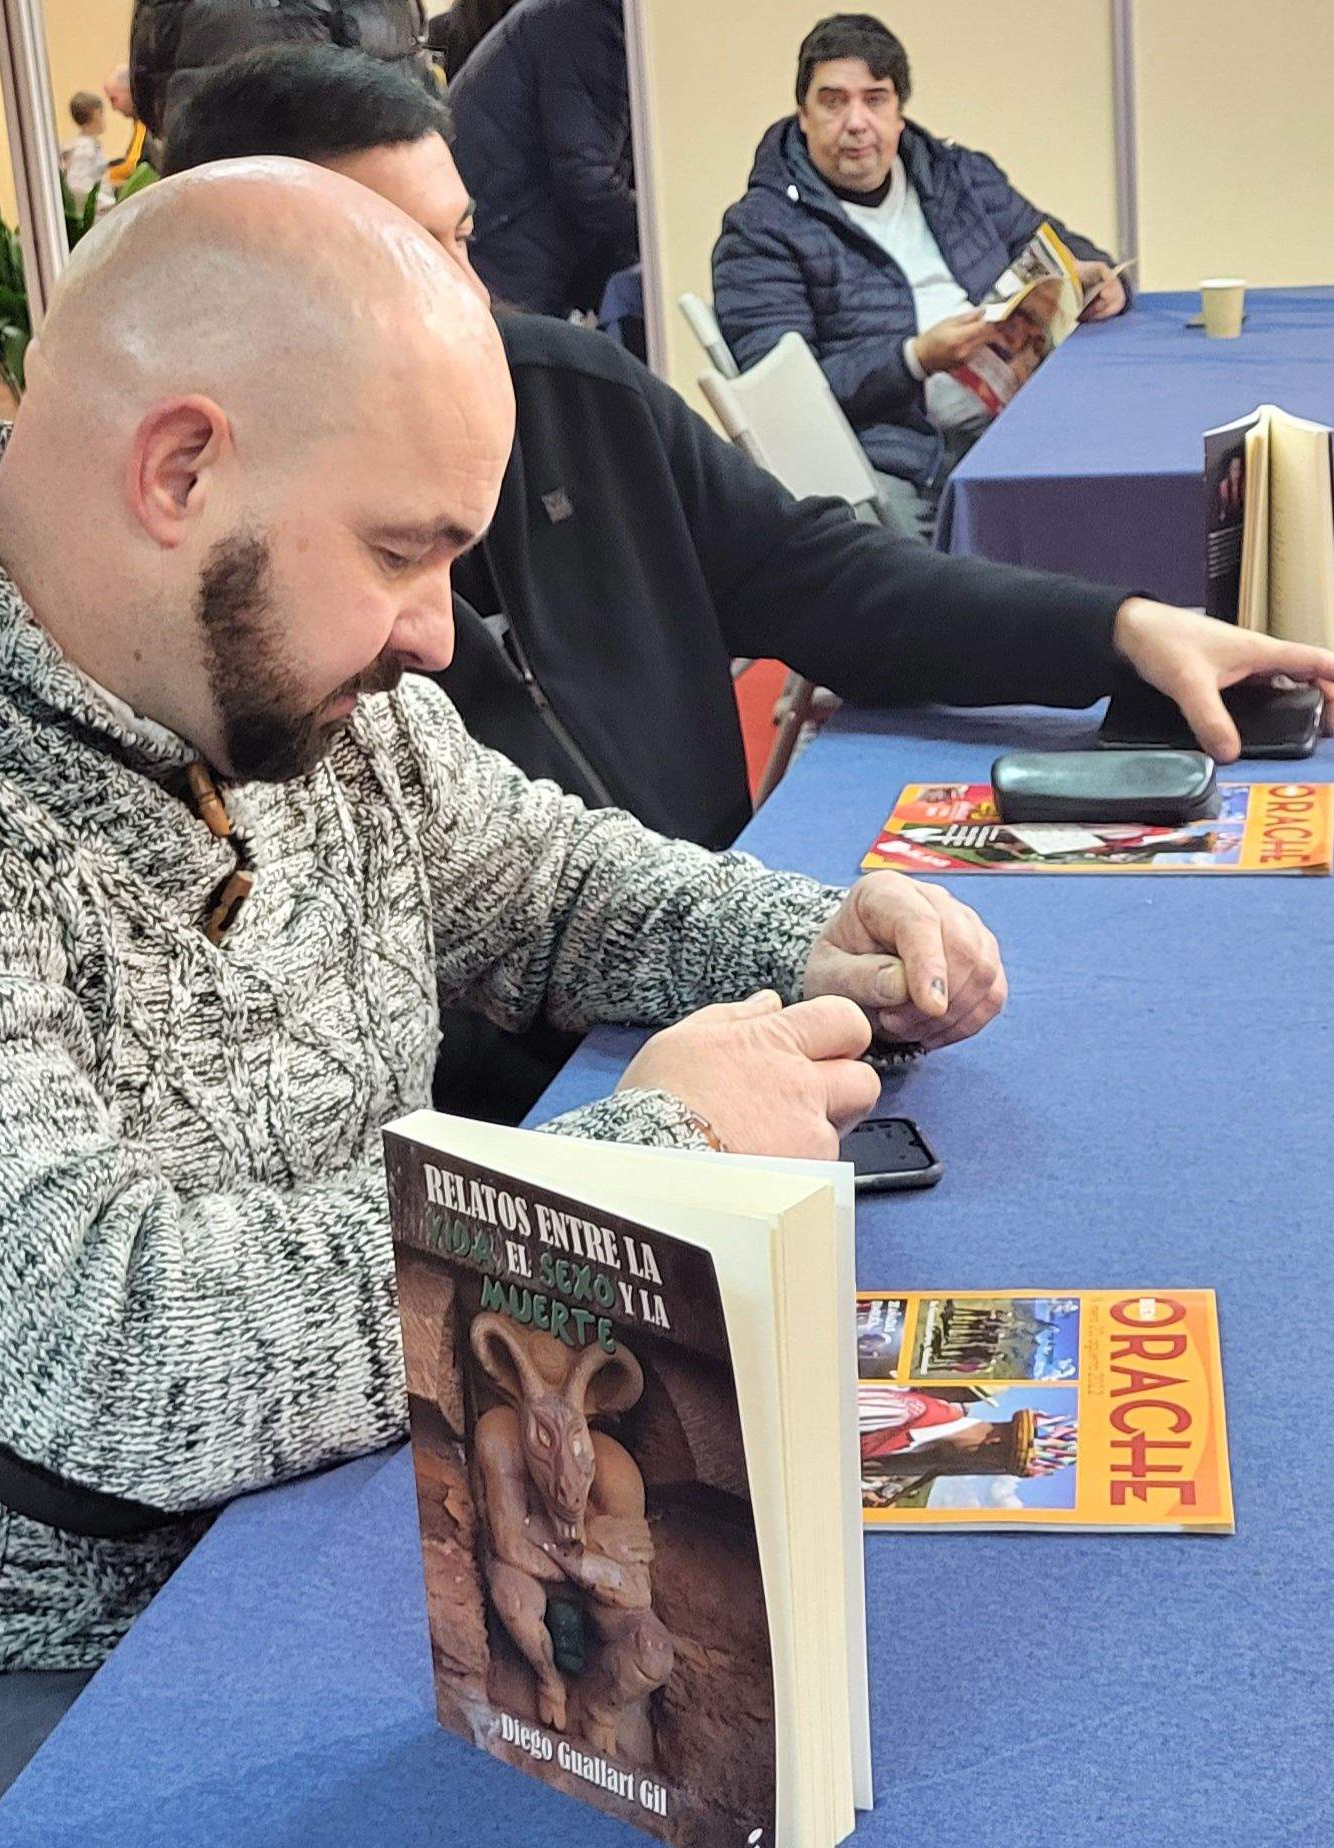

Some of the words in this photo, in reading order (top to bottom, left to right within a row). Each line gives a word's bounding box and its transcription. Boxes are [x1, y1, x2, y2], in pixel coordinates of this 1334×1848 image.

[1260, 785, 1316, 864] ORACHE
[423, 1163, 532, 1237] RELATOS
[533, 1202, 621, 1270] ENTRE
[623, 1235, 664, 1286] LA
[480, 1274, 617, 1355] MUERTE
[504, 1240, 533, 1279] EL
[539, 1251, 616, 1308] SEXO
[617, 1281, 635, 1316] Y
[638, 1288, 671, 1330] LA
[1109, 1297, 1197, 1506] ORACHE
[499, 1711, 553, 1762] Diego
[557, 1740, 635, 1801] Guallart
[639, 1778, 668, 1817] Gil
